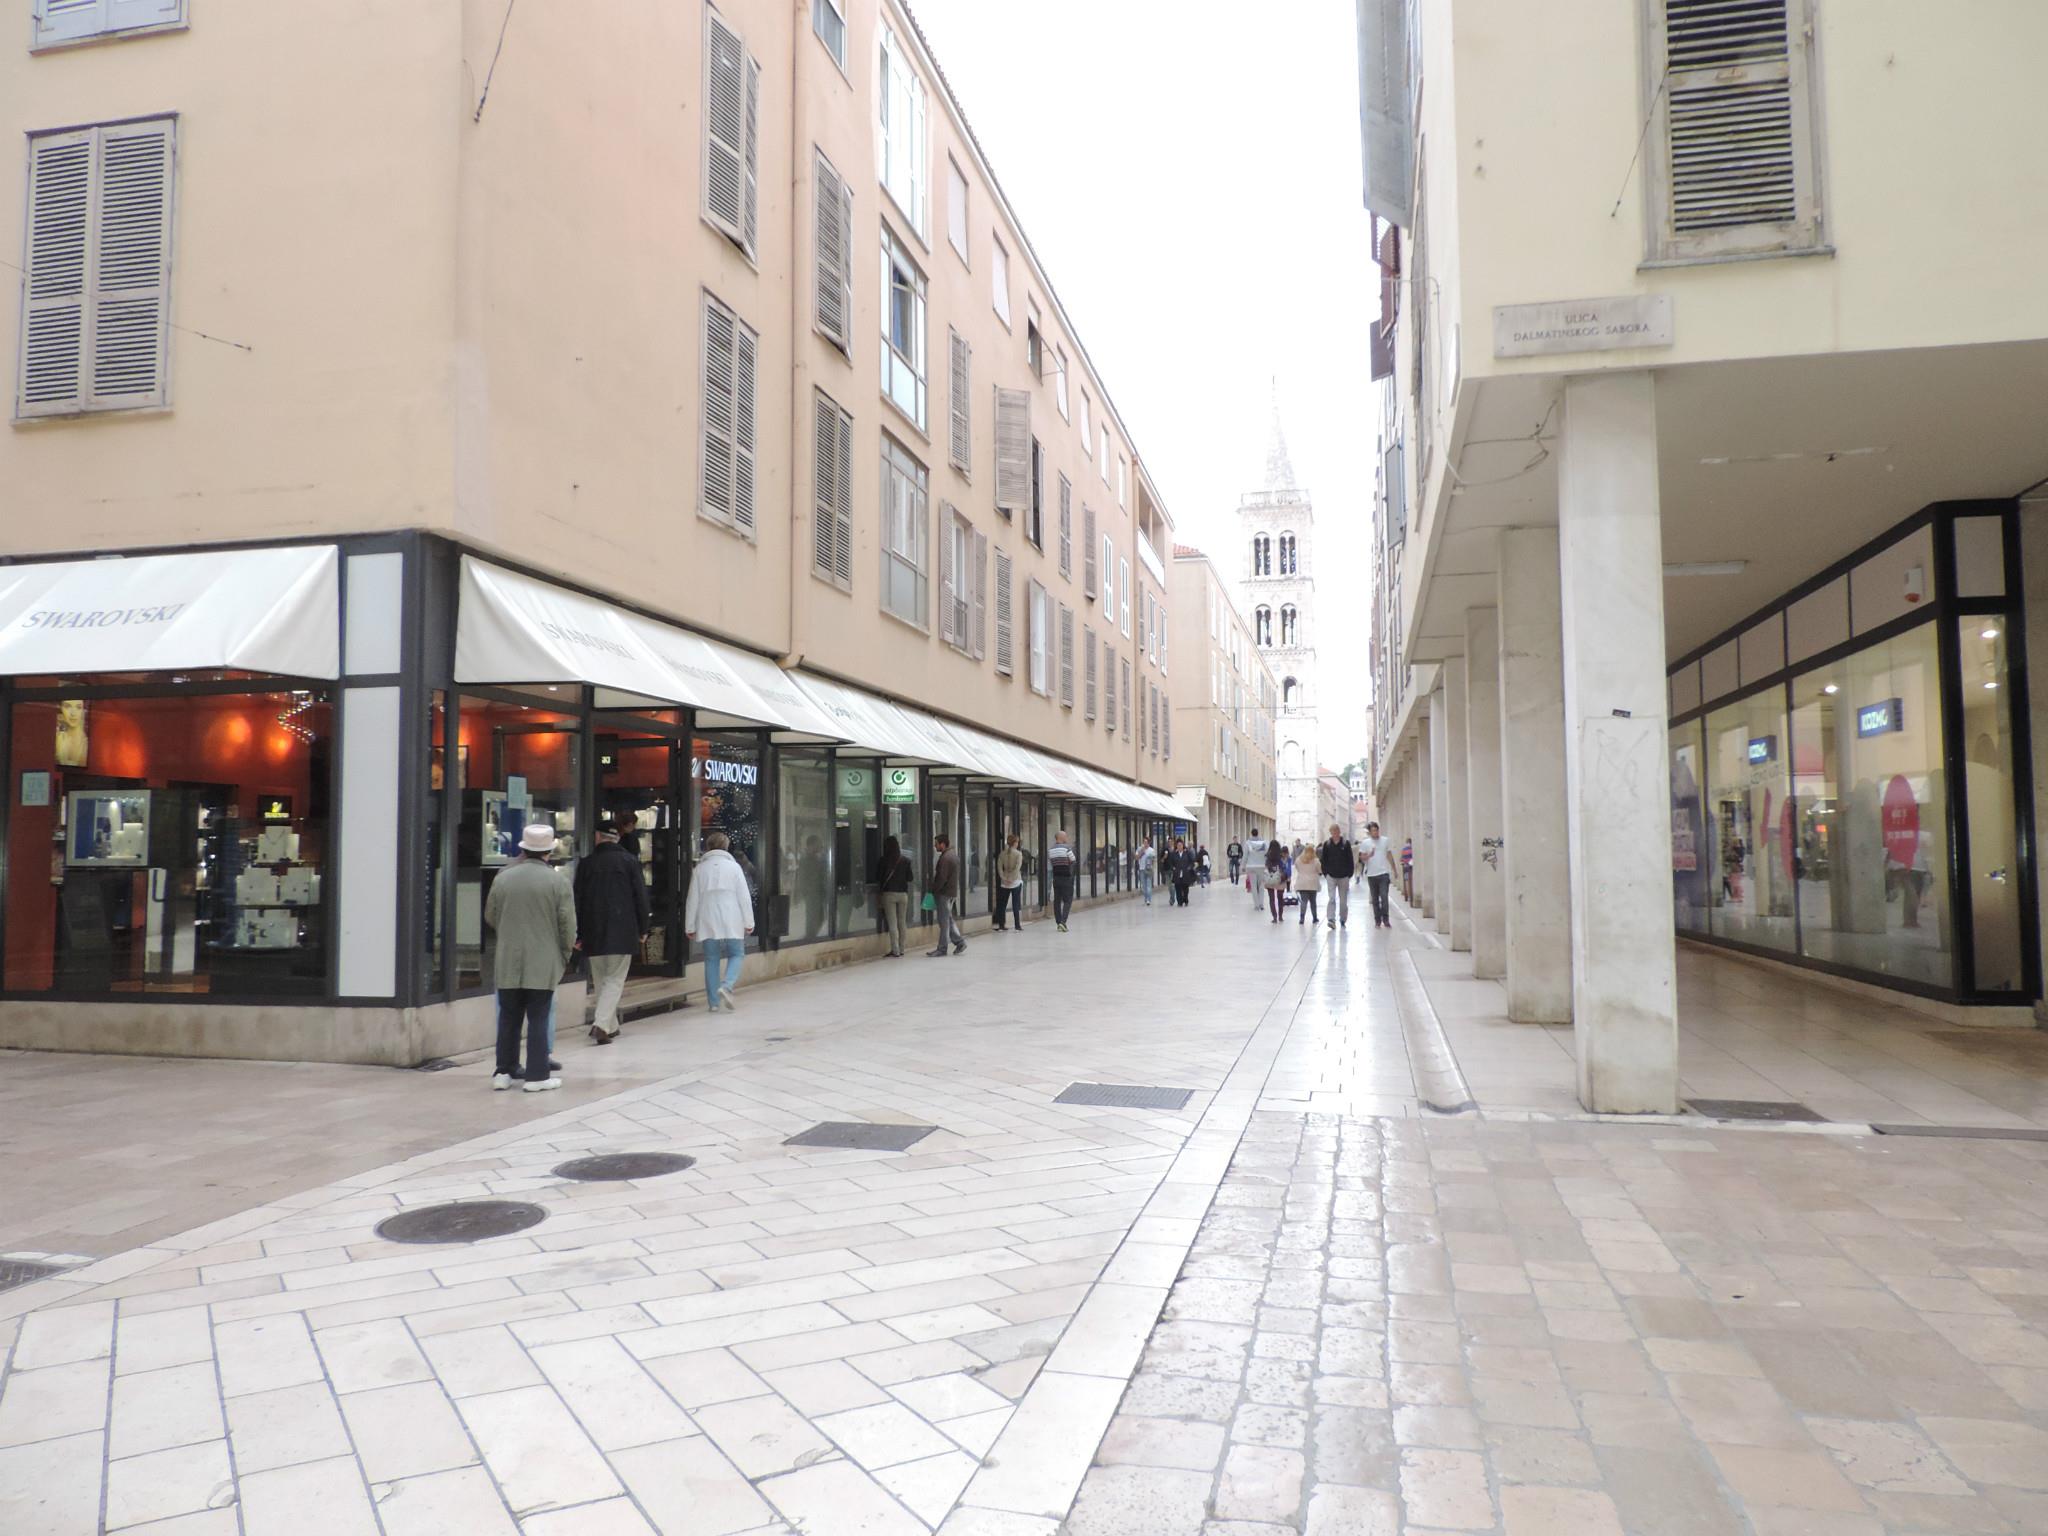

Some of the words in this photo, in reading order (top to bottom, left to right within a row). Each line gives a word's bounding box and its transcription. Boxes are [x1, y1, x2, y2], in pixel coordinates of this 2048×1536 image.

[1565, 313, 1599, 325] ULICA
[1513, 327, 1600, 342] DALMATINSKOG
[1605, 323, 1650, 335] SABORA
[22, 603, 187, 629] SWAROVSKI
[705, 760, 758, 785] SWAROVSKI
